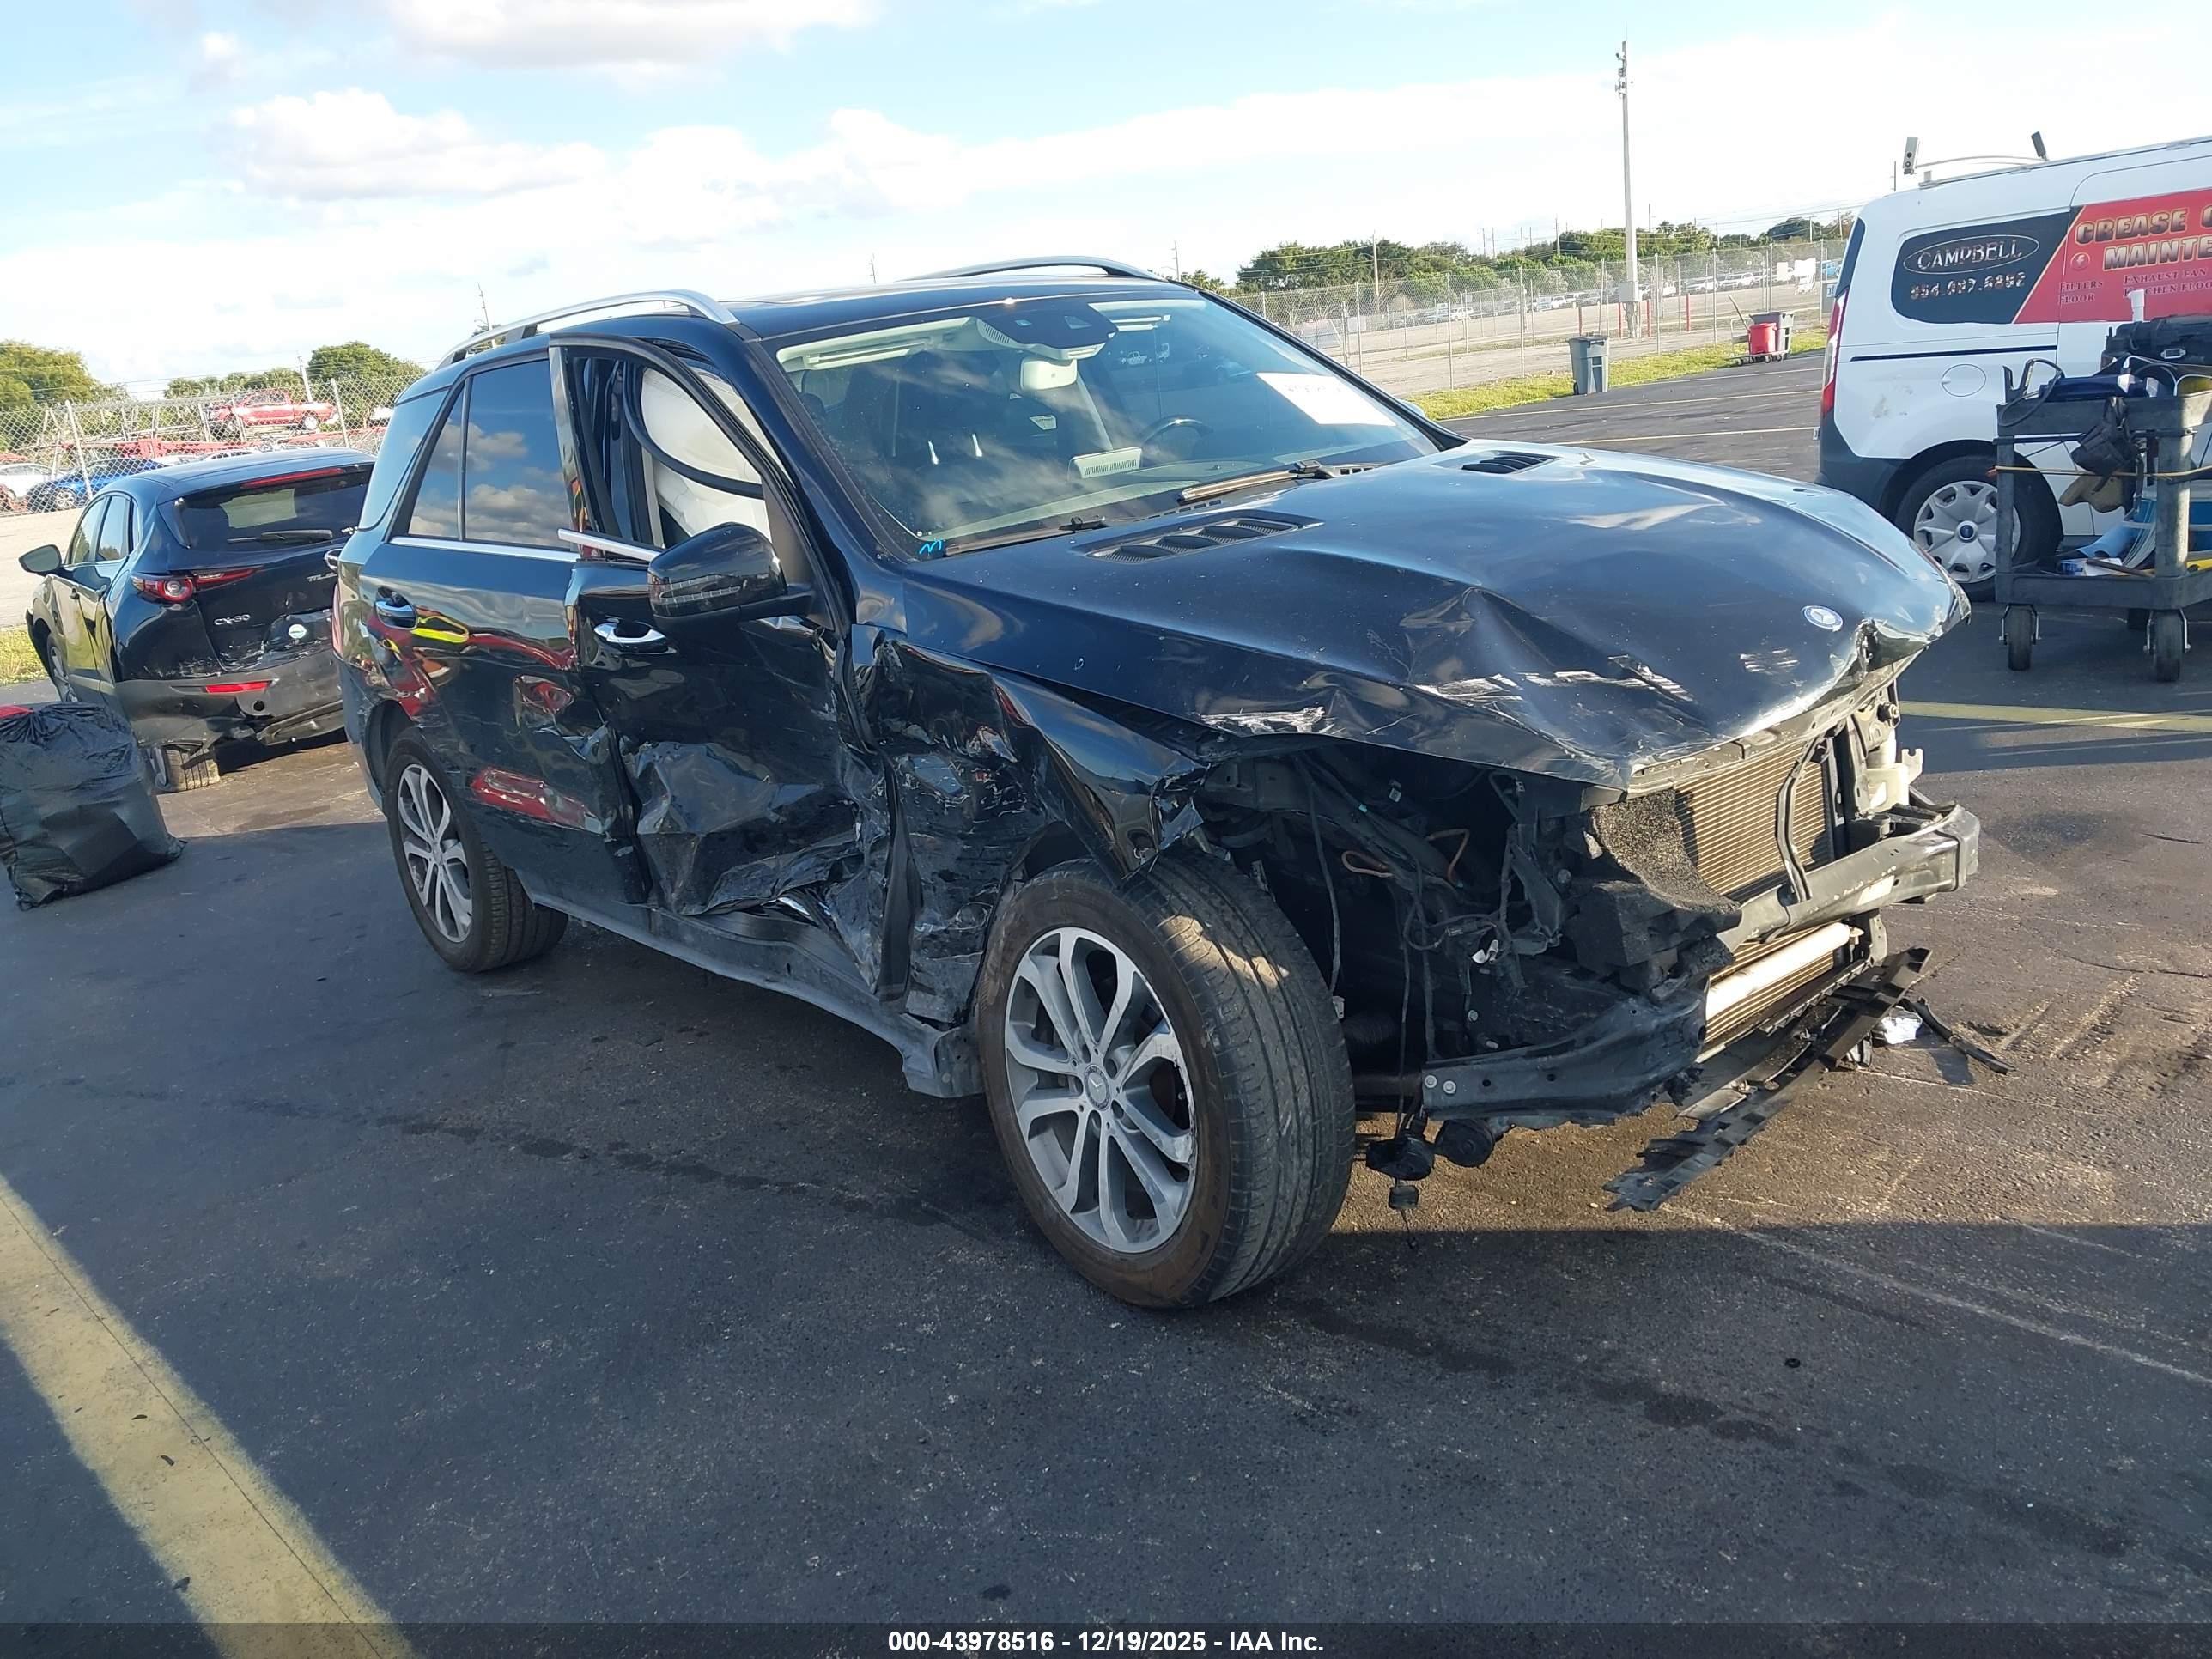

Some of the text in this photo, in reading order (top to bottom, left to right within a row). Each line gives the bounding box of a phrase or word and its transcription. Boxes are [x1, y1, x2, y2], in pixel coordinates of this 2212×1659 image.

[2075, 209, 2188, 245] GREASE
[1917, 240, 2022, 270] CAMPBELL
[2124, 268, 2207, 285] EXHAUST FAN
[2060, 281, 2103, 292] FILTERS
[2124, 284, 2177, 297] KCHEN
[2059, 295, 2095, 305] FLOOR
[215, 614, 251, 626] CX-30
